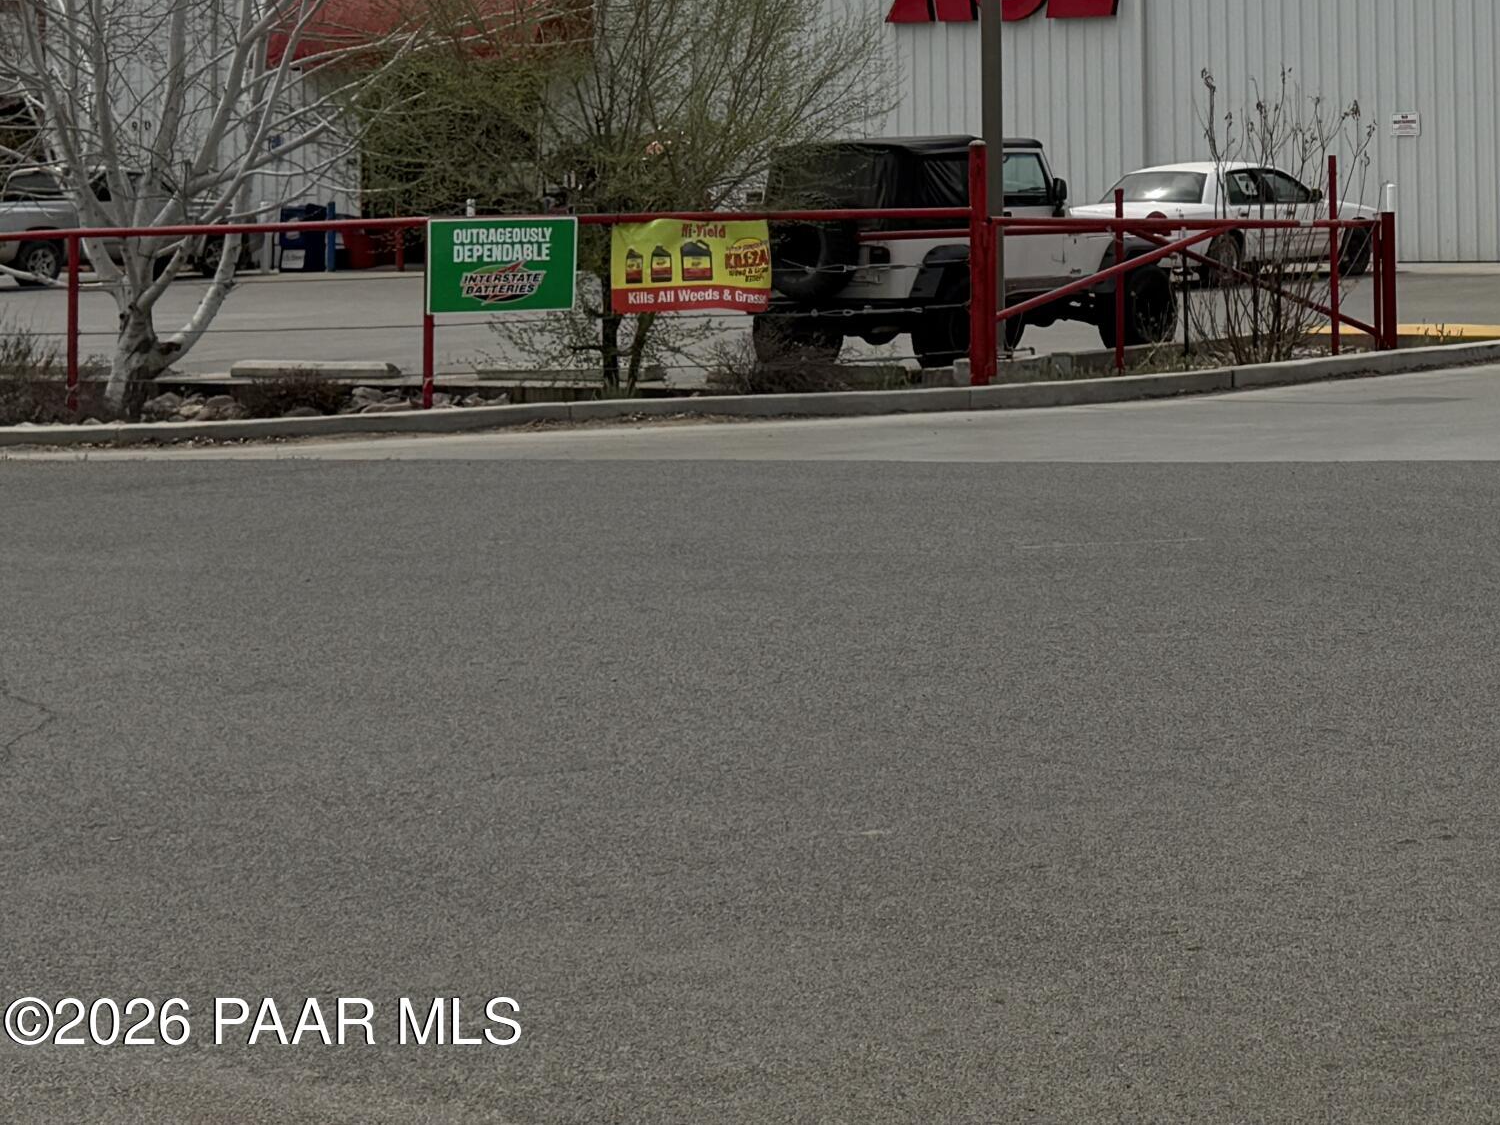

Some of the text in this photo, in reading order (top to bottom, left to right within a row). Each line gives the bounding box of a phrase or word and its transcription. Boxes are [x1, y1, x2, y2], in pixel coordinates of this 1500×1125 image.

[453, 227, 553, 244] OUTRAGEOUSLY
[681, 222, 726, 238] Hi-Yield
[453, 243, 552, 263] DEPENDABLE
[463, 272, 542, 284] INTERSTATE
[465, 283, 537, 295] BATTERIES
[628, 291, 655, 305] Kills
[657, 290, 675, 303] All
[678, 288, 720, 302] Weeds
[722, 290, 732, 301] &
